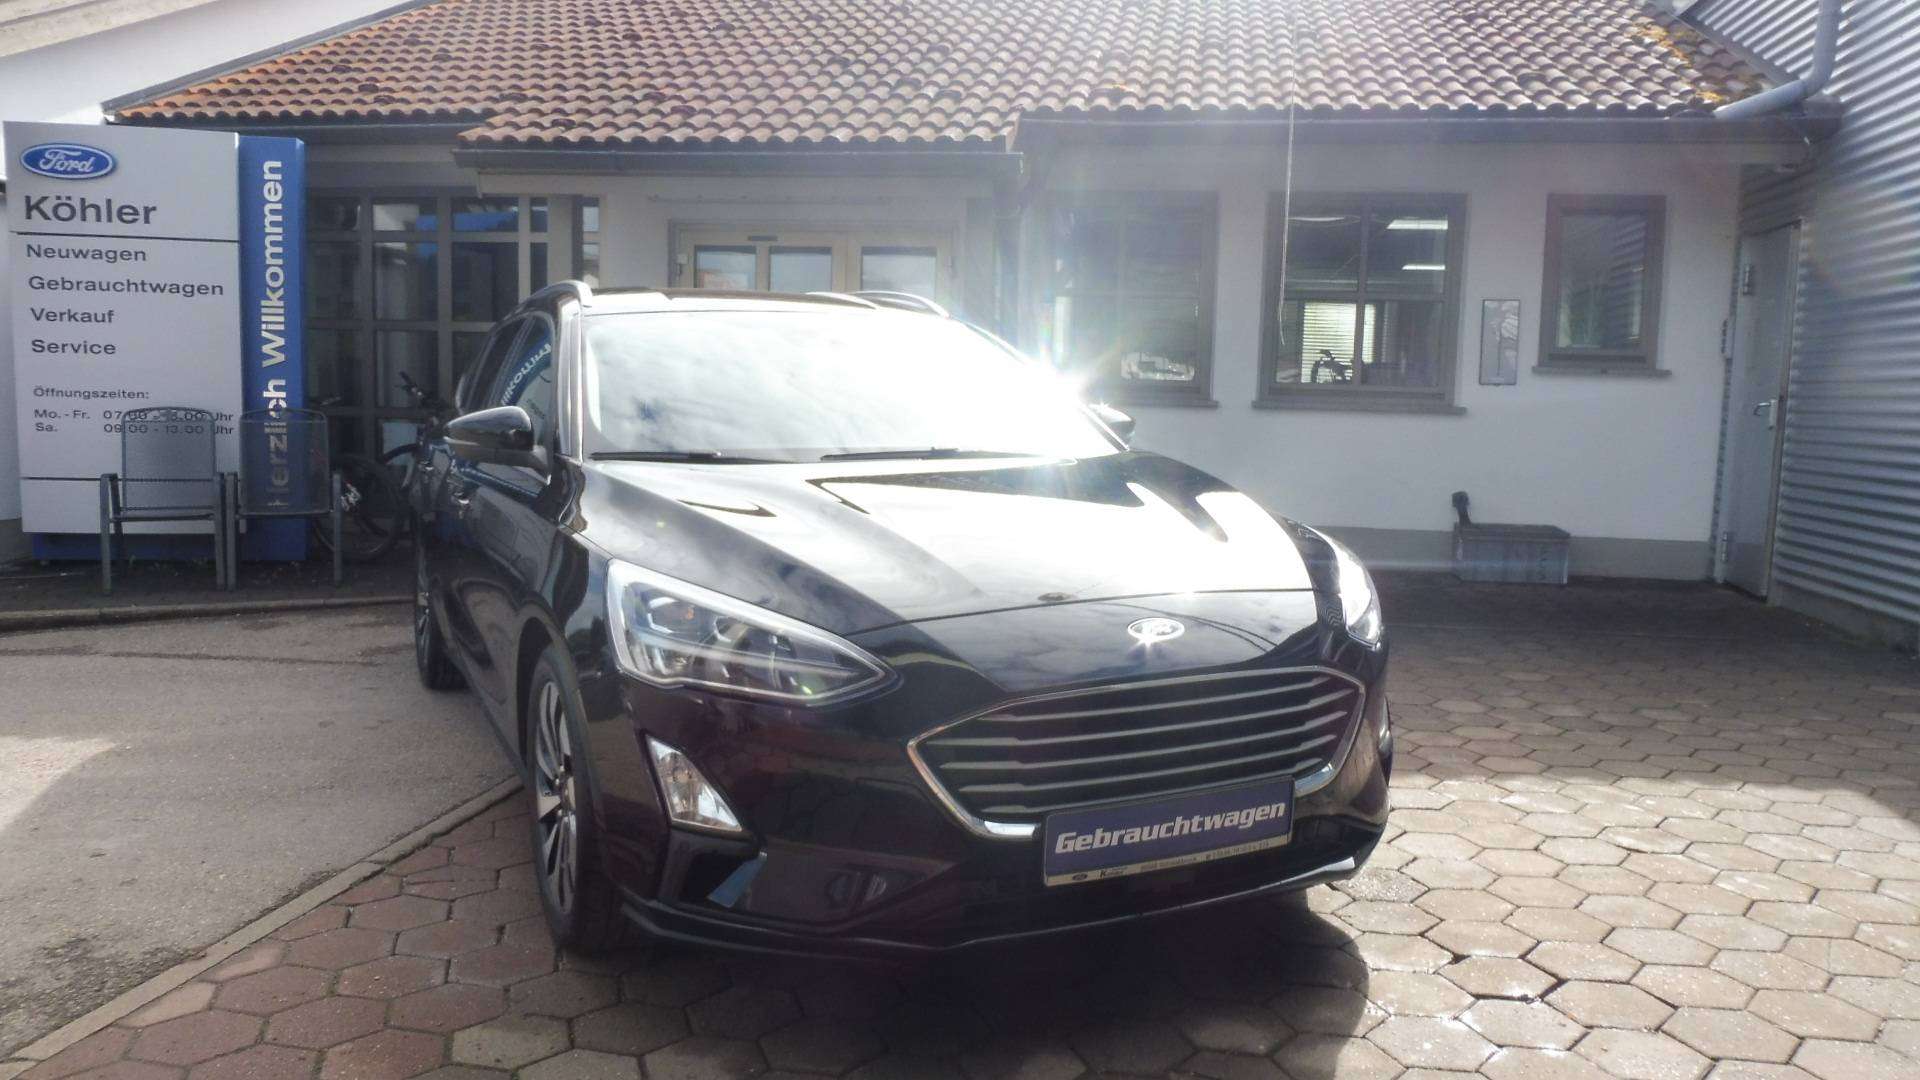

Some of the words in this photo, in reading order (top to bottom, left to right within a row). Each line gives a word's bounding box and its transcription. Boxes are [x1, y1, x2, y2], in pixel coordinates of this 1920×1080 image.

[39, 148, 97, 173] Ford
[24, 194, 157, 224] Köhler
[25, 243, 147, 263] Neuwagen
[260, 160, 286, 368] Willkommen
[28, 275, 224, 298] Gebrauchtwagen
[30, 307, 115, 323] Verkauf
[31, 339, 116, 355] Service
[33, 385, 149, 399] Öffnungszeiten:
[35, 422, 57, 432] Sa.
[1055, 802, 1286, 854] Gebrauchtwagen
